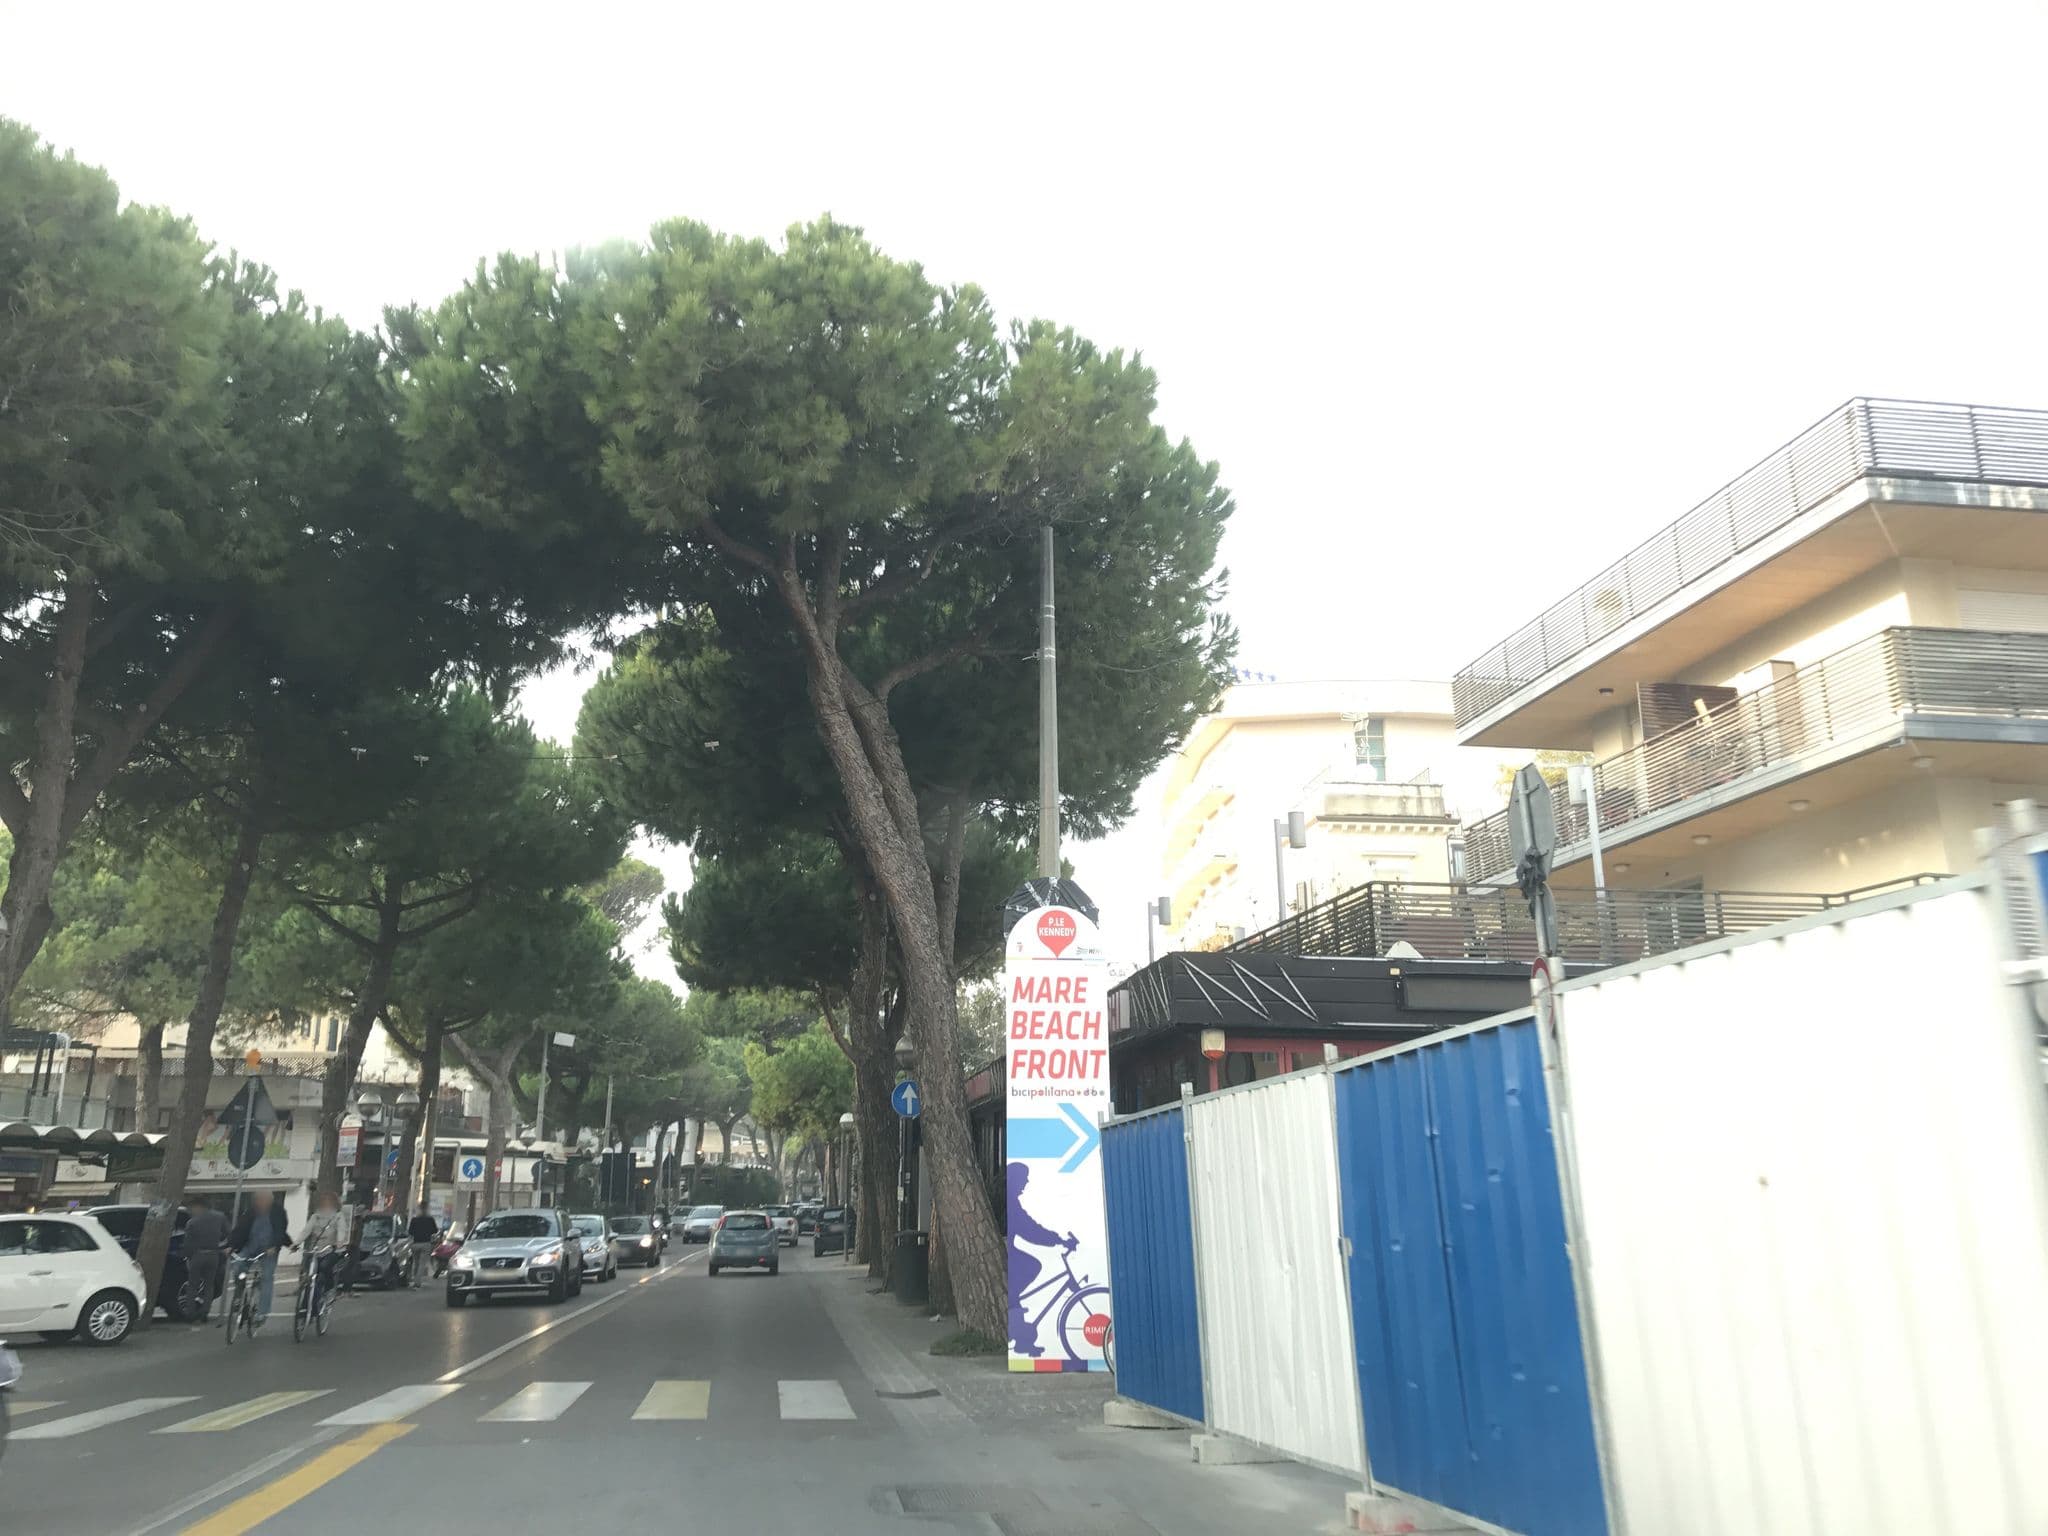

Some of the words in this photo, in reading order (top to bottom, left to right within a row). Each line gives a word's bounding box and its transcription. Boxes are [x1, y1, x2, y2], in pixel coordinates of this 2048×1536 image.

[1039, 927, 1075, 937] KENNEDY
[1048, 917, 1065, 927] P.LE
[1012, 976, 1089, 1003] MARE
[1011, 1011, 1101, 1040] BEACH
[1011, 1049, 1107, 1079] FRONT
